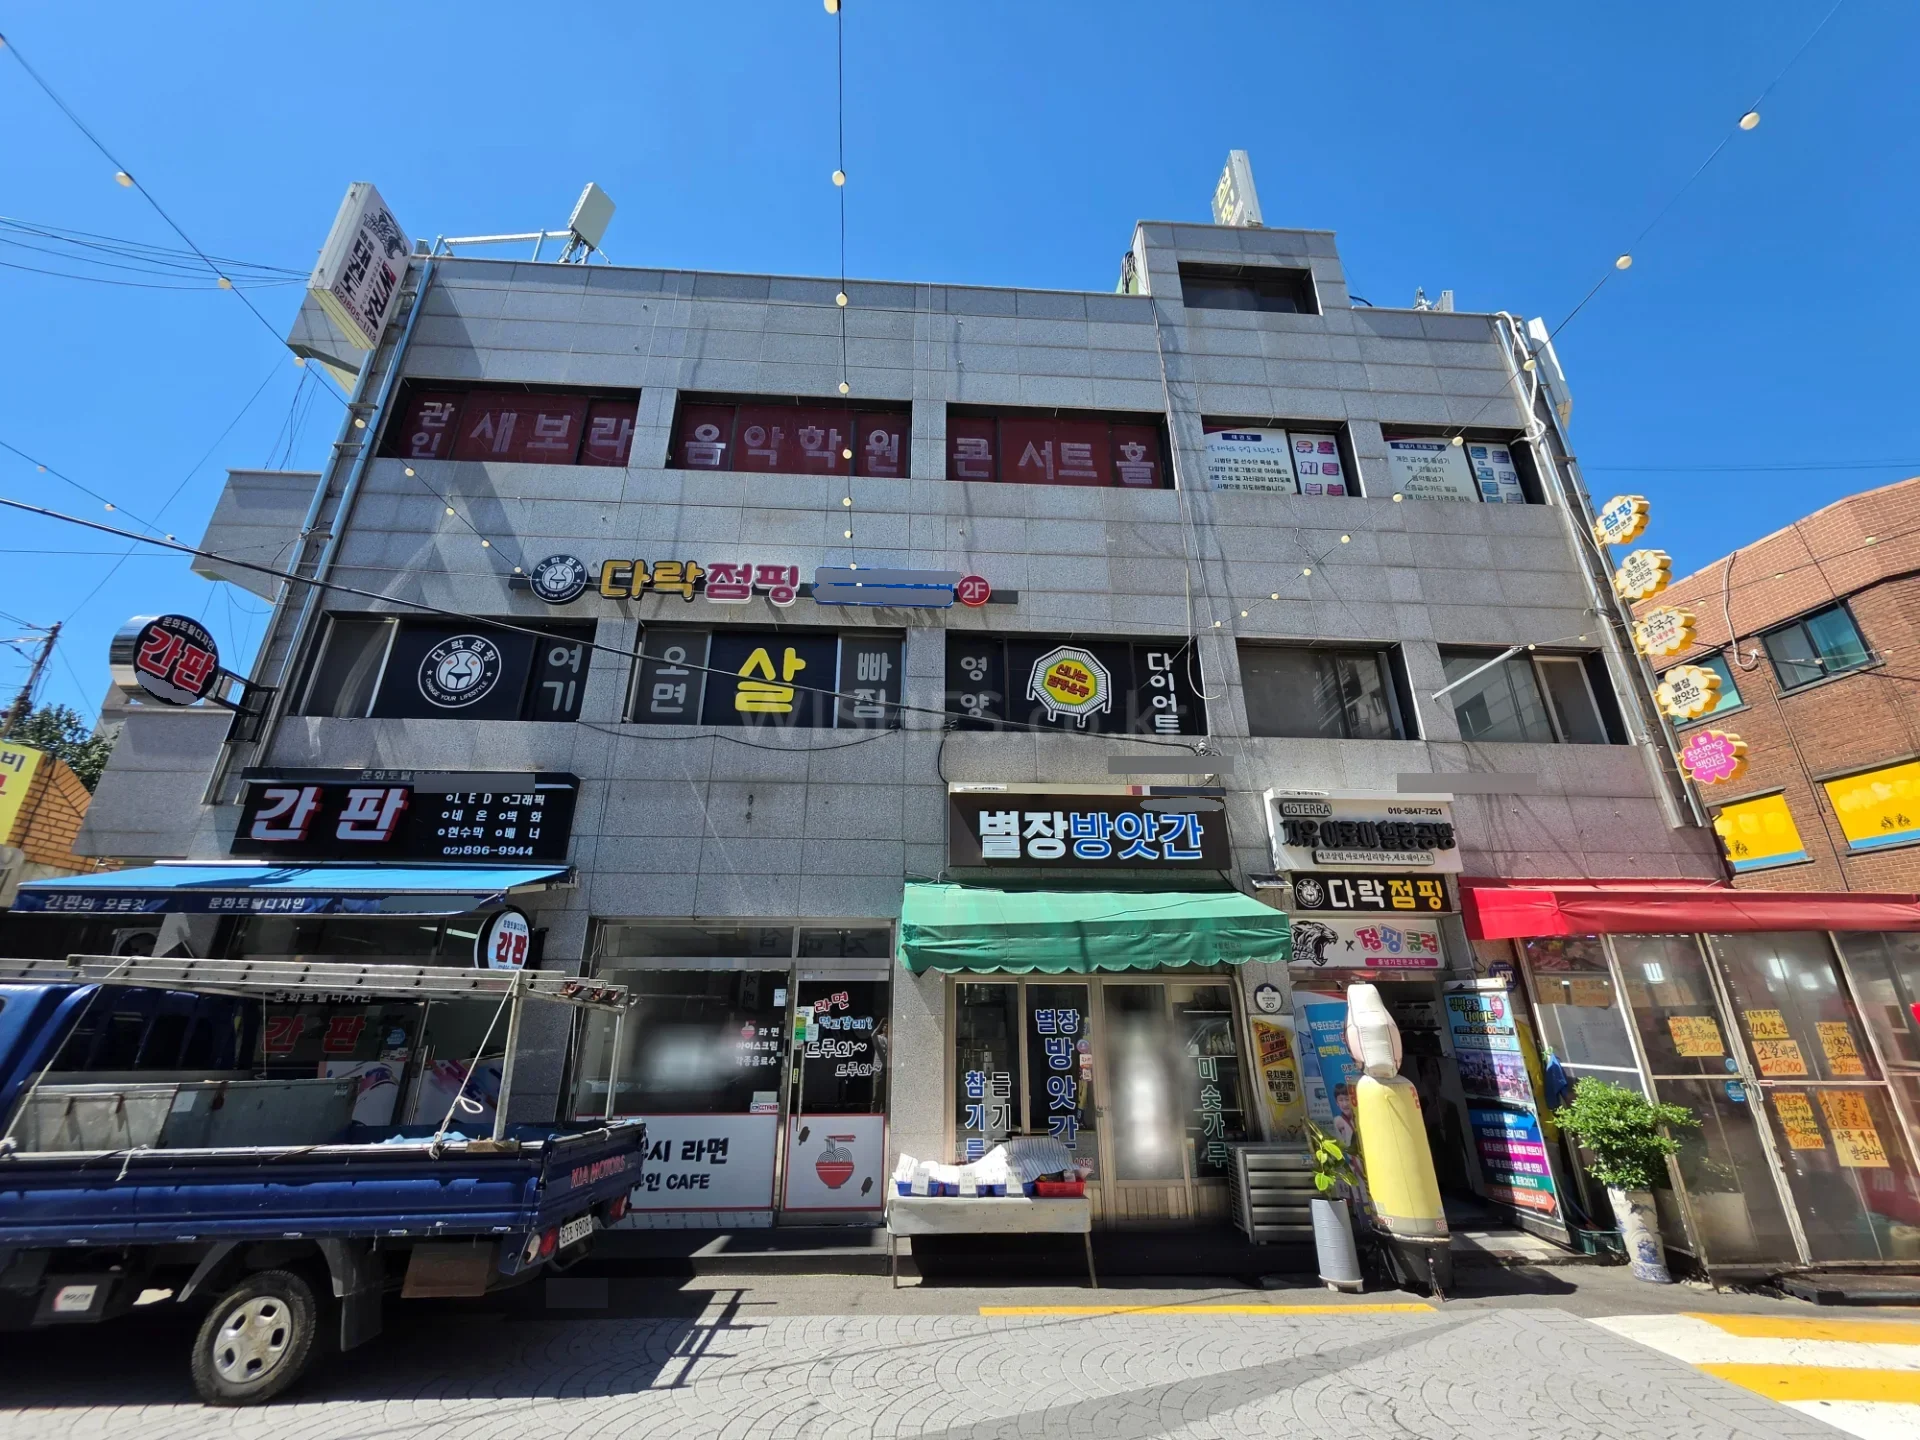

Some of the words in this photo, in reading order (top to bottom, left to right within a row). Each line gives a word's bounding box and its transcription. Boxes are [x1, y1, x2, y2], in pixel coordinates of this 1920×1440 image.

[411, 402, 455, 458] 관인
[470, 408, 634, 460] 새보라
[685, 422, 900, 473] 음악학원
[953, 437, 1155, 485] 콘서트홀
[1602, 500, 1633, 531] 점핑
[962, 581, 986, 599] 2F
[1640, 614, 1676, 638] 칼국수
[137, 626, 217, 693] 간판
[432, 639, 496, 663] 다락점핑
[543, 644, 583, 713] 여기
[651, 646, 690, 713] 오면
[735, 647, 807, 713] 살
[852, 651, 893, 719] 빠짐
[1055, 664, 1089, 684] 신나는
[1672, 677, 1691, 692] 별장
[426, 677, 440, 698] CHANGE
[440, 694, 457, 702] YOUR
[459, 680, 489, 701] LIFESTYLE
[961, 656, 990, 718] 영양
[1147, 652, 1181, 734] 다이어트
[1672, 686, 1701, 706] 방앗간
[511, 793, 545, 806] 그래픽
[251, 786, 409, 842] 간판
[1388, 807, 1443, 816] 010-5847-7251
[448, 827, 484, 839] 현수막
[979, 810, 1204, 861] 별장방앗간
[443, 845, 533, 857] 02)896-9944
[44, 894, 96, 911] 간판의
[104, 898, 147, 911] 모든것
[208, 897, 306, 911] 문화토탈디자인
[1327, 879, 1444, 911] 다락점핑
[495, 931, 528, 966] 간판
[814, 991, 849, 1013] 라면
[758, 1026, 780, 1037] 라면
[819, 1016, 873, 1030] 먹고갈래?
[1035, 1008, 1080, 1035] 별장
[261, 1014, 368, 1054] 간판
[735, 1040, 779, 1051] 아이스크림
[805, 1038, 867, 1059] 드루와~
[735, 1055, 777, 1067] 각종음료수
[835, 1061, 883, 1077] 드루와~
[1266, 1070, 1294, 1081] 유치원생
[1276, 1092, 1291, 1102] 모집
[990, 1072, 1012, 1146] 들기
[1198, 1057, 1228, 1168] 미숫가루
[682, 1137, 730, 1165] 라면
[571, 1165, 589, 1189] KIA
[590, 1154, 626, 1184] MOTORS
[666, 1172, 711, 1190] CAFE
